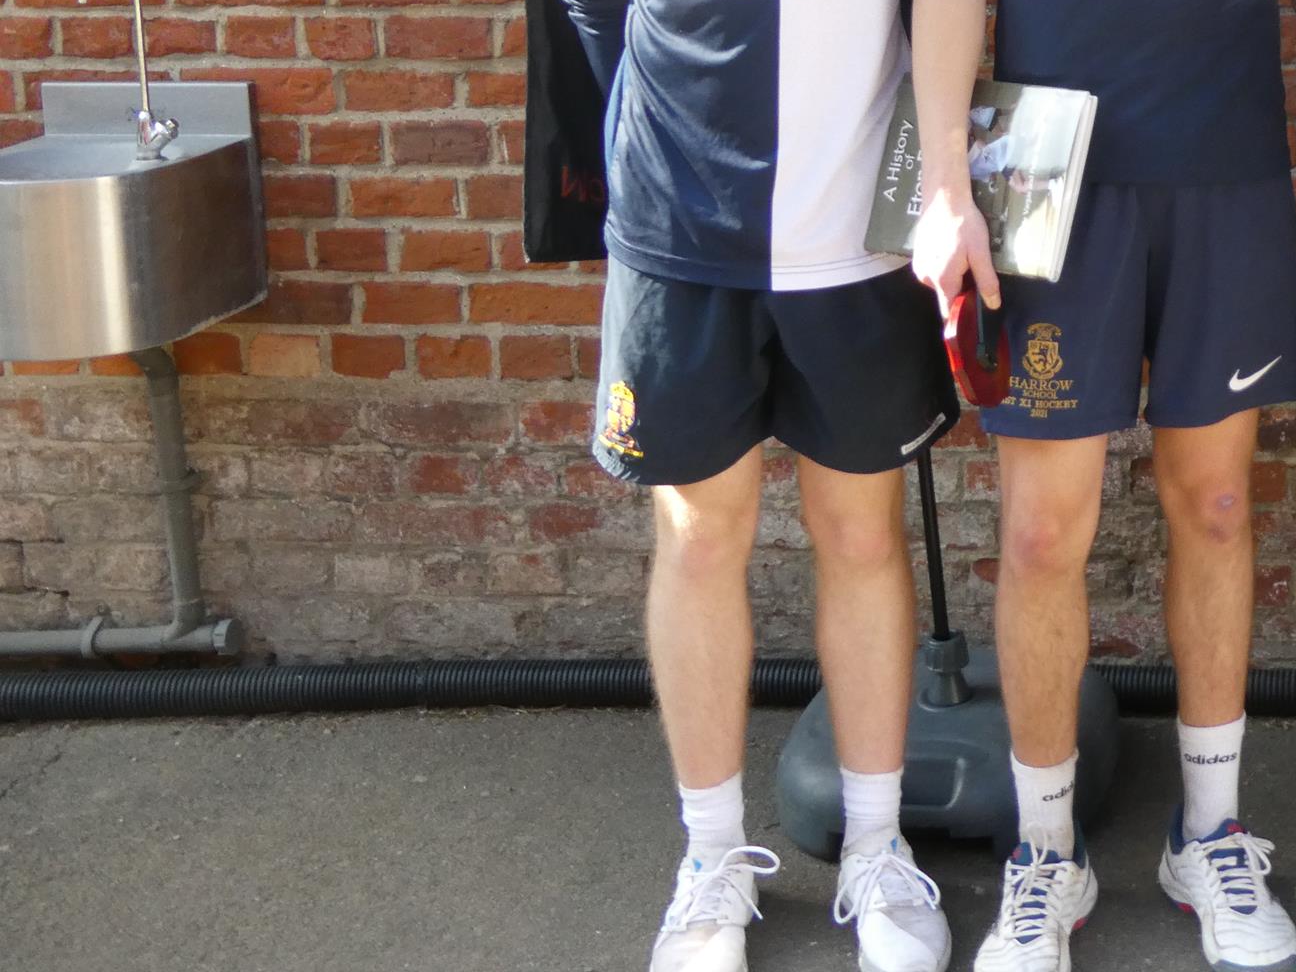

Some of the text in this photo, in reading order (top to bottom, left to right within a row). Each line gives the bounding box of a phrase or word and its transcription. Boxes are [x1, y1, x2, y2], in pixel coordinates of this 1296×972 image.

[883, 119, 914, 202] A History
[905, 153, 915, 170] of
[1009, 375, 1074, 391] HARROW
[1023, 389, 1058, 400] SCHOOL
[1019, 398, 1032, 408] XI
[1035, 399, 1078, 409] HOCKEY
[1183, 752, 1238, 765] adidas
[1042, 780, 1074, 802] adid
